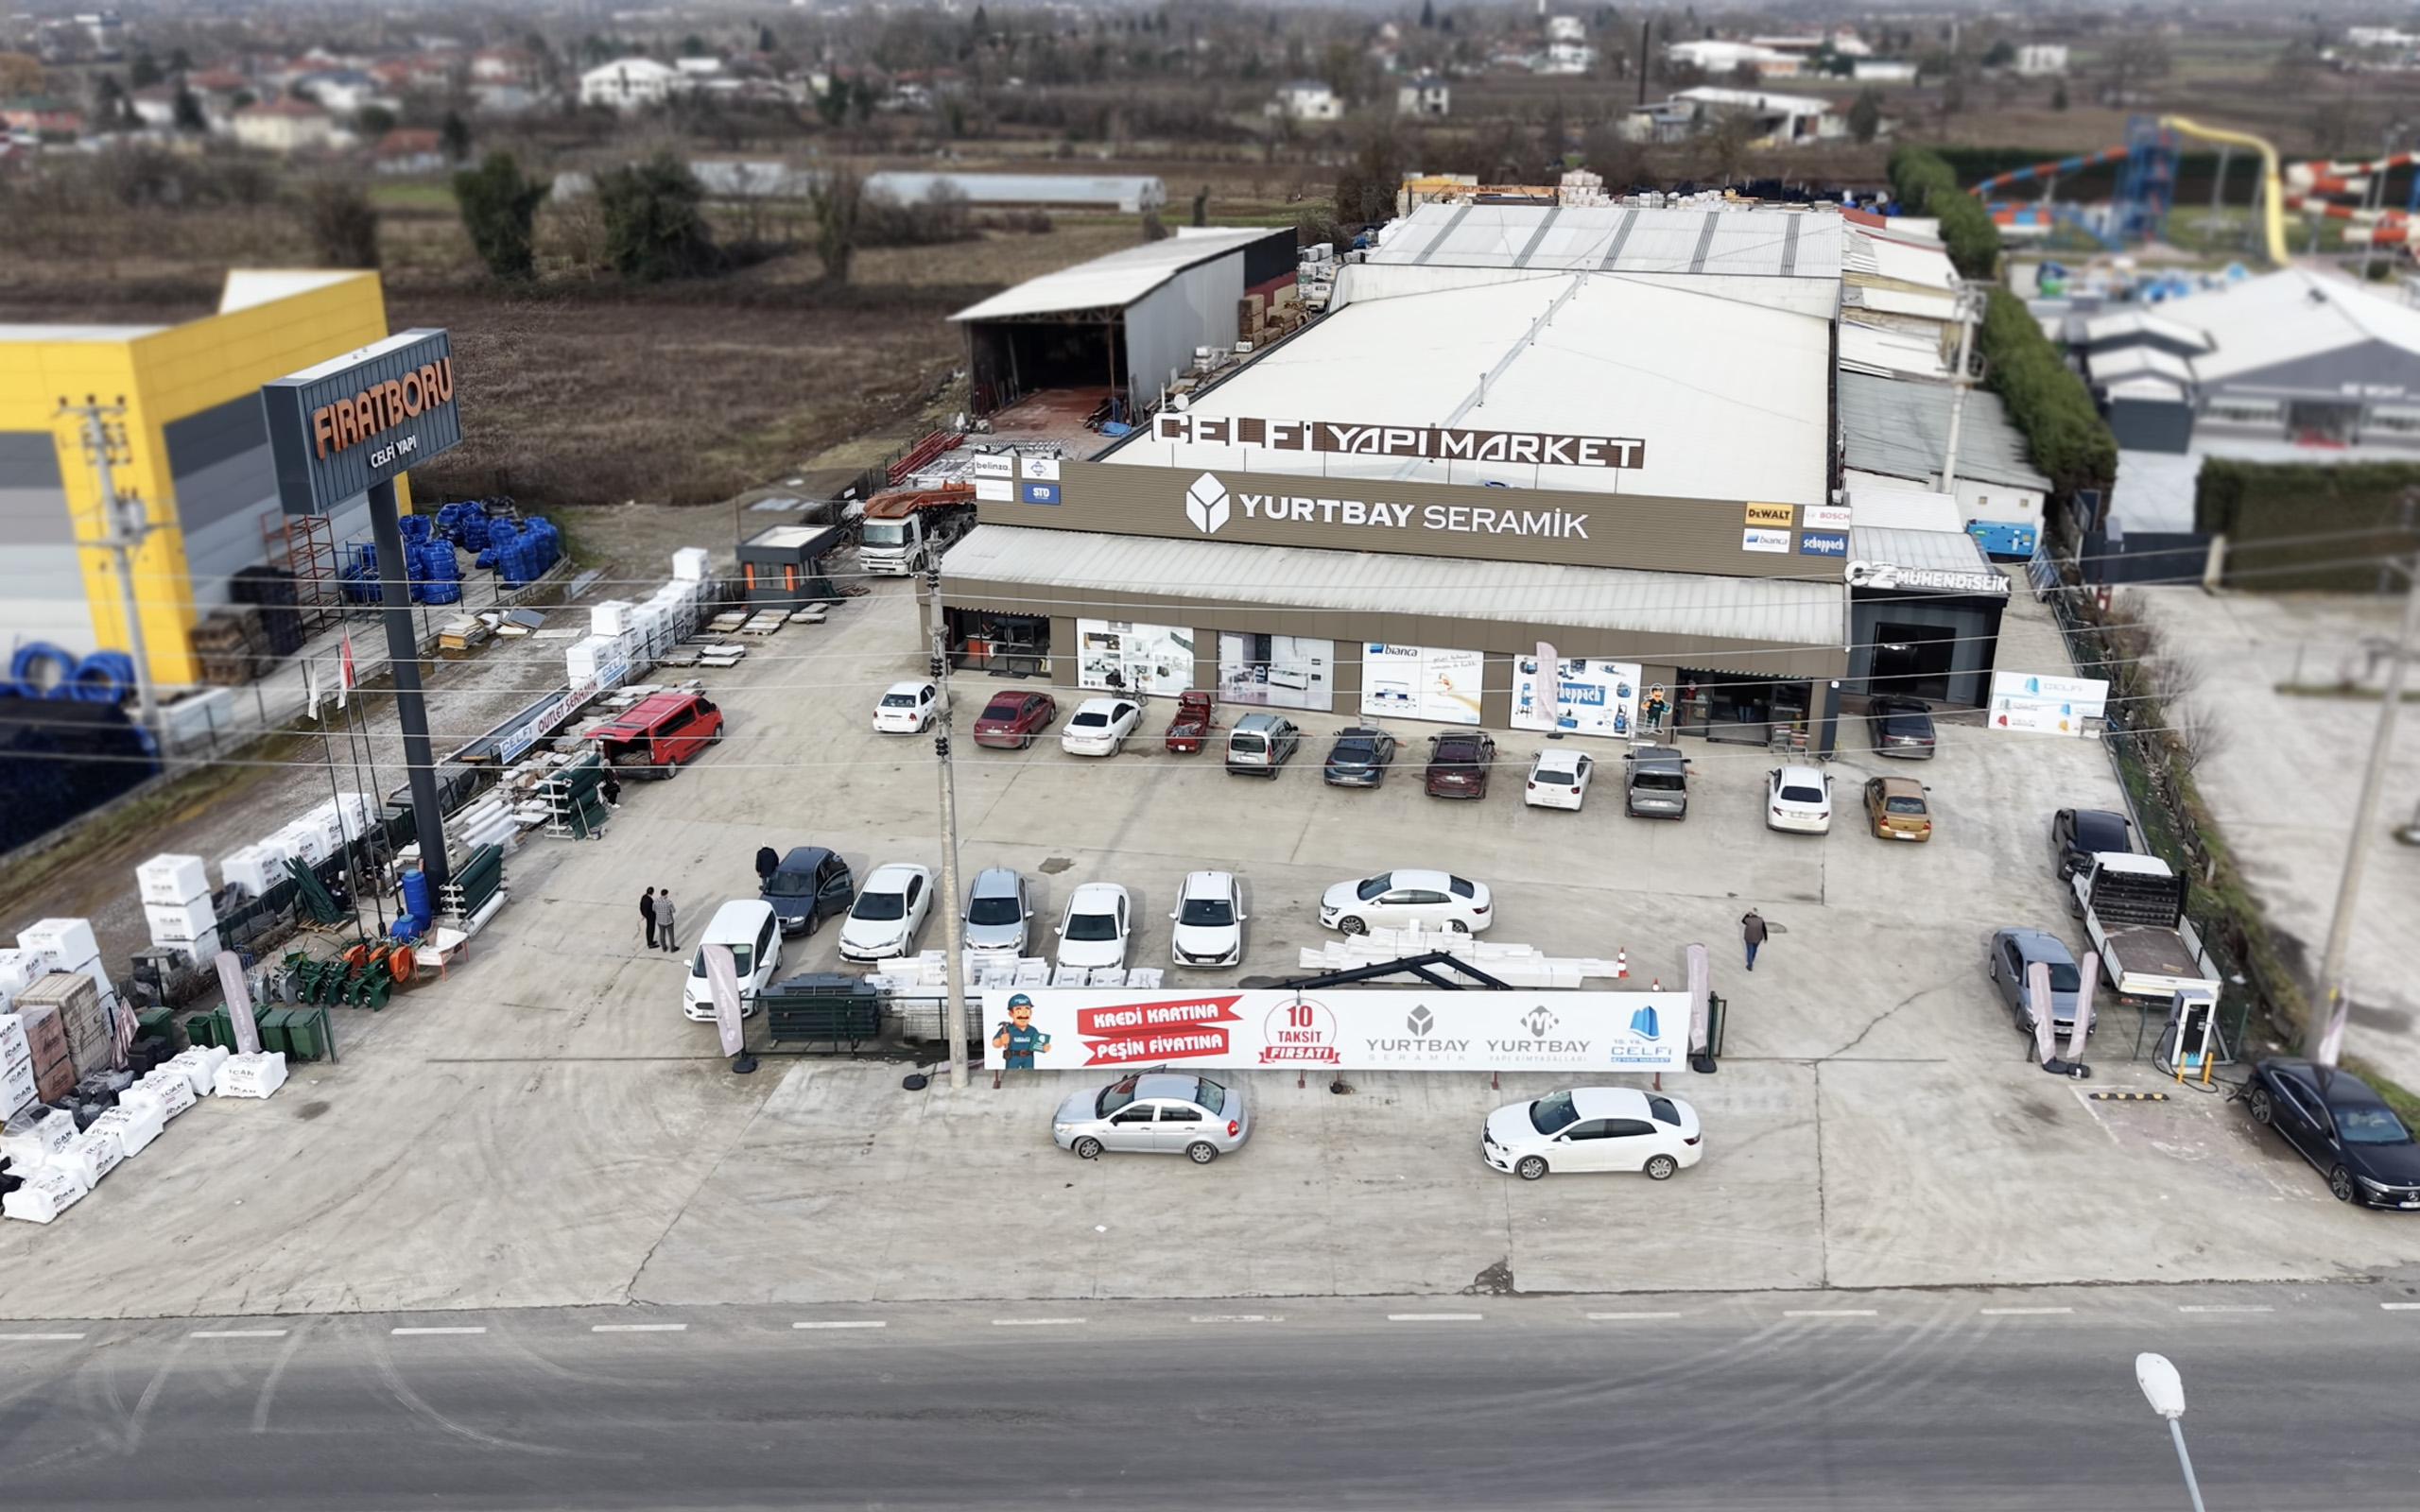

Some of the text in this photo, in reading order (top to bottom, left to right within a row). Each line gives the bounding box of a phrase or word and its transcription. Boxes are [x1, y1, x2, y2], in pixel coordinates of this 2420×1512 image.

[313, 356, 453, 459] FIRATBORU
[396, 435, 417, 455] YAPI
[1326, 423, 1427, 467] YAPI
[1440, 430, 1641, 477] MARKET
[1238, 493, 1589, 539] YURTBAY SERAMİK
[1820, 511, 1850, 520] BOSCH
[1759, 535, 1788, 545] bianca
[1803, 536, 1844, 553] scheppach
[1385, 644, 1418, 657] bianca
[538, 703, 564, 734] OUTLET
[1094, 1004, 1219, 1028] KREDİ KARTINA
[1287, 1005, 1312, 1027] 10
[1278, 1029, 1322, 1043] TAKSİT
[1097, 1034, 1223, 1060] PEŞİN FİYATINA
[1270, 1046, 1330, 1058] FIRSATI
[1367, 1040, 1470, 1052] YURTBAY
[1487, 1040, 1591, 1053] YURTBAY
[1369, 1053, 1464, 1061] SERAMİK
[9, 1065, 27, 1084] ICAN
[12, 1085, 31, 1103] ICAN
[162, 1082, 183, 1097] ICAN
[54, 1130, 72, 1146] ICAN
